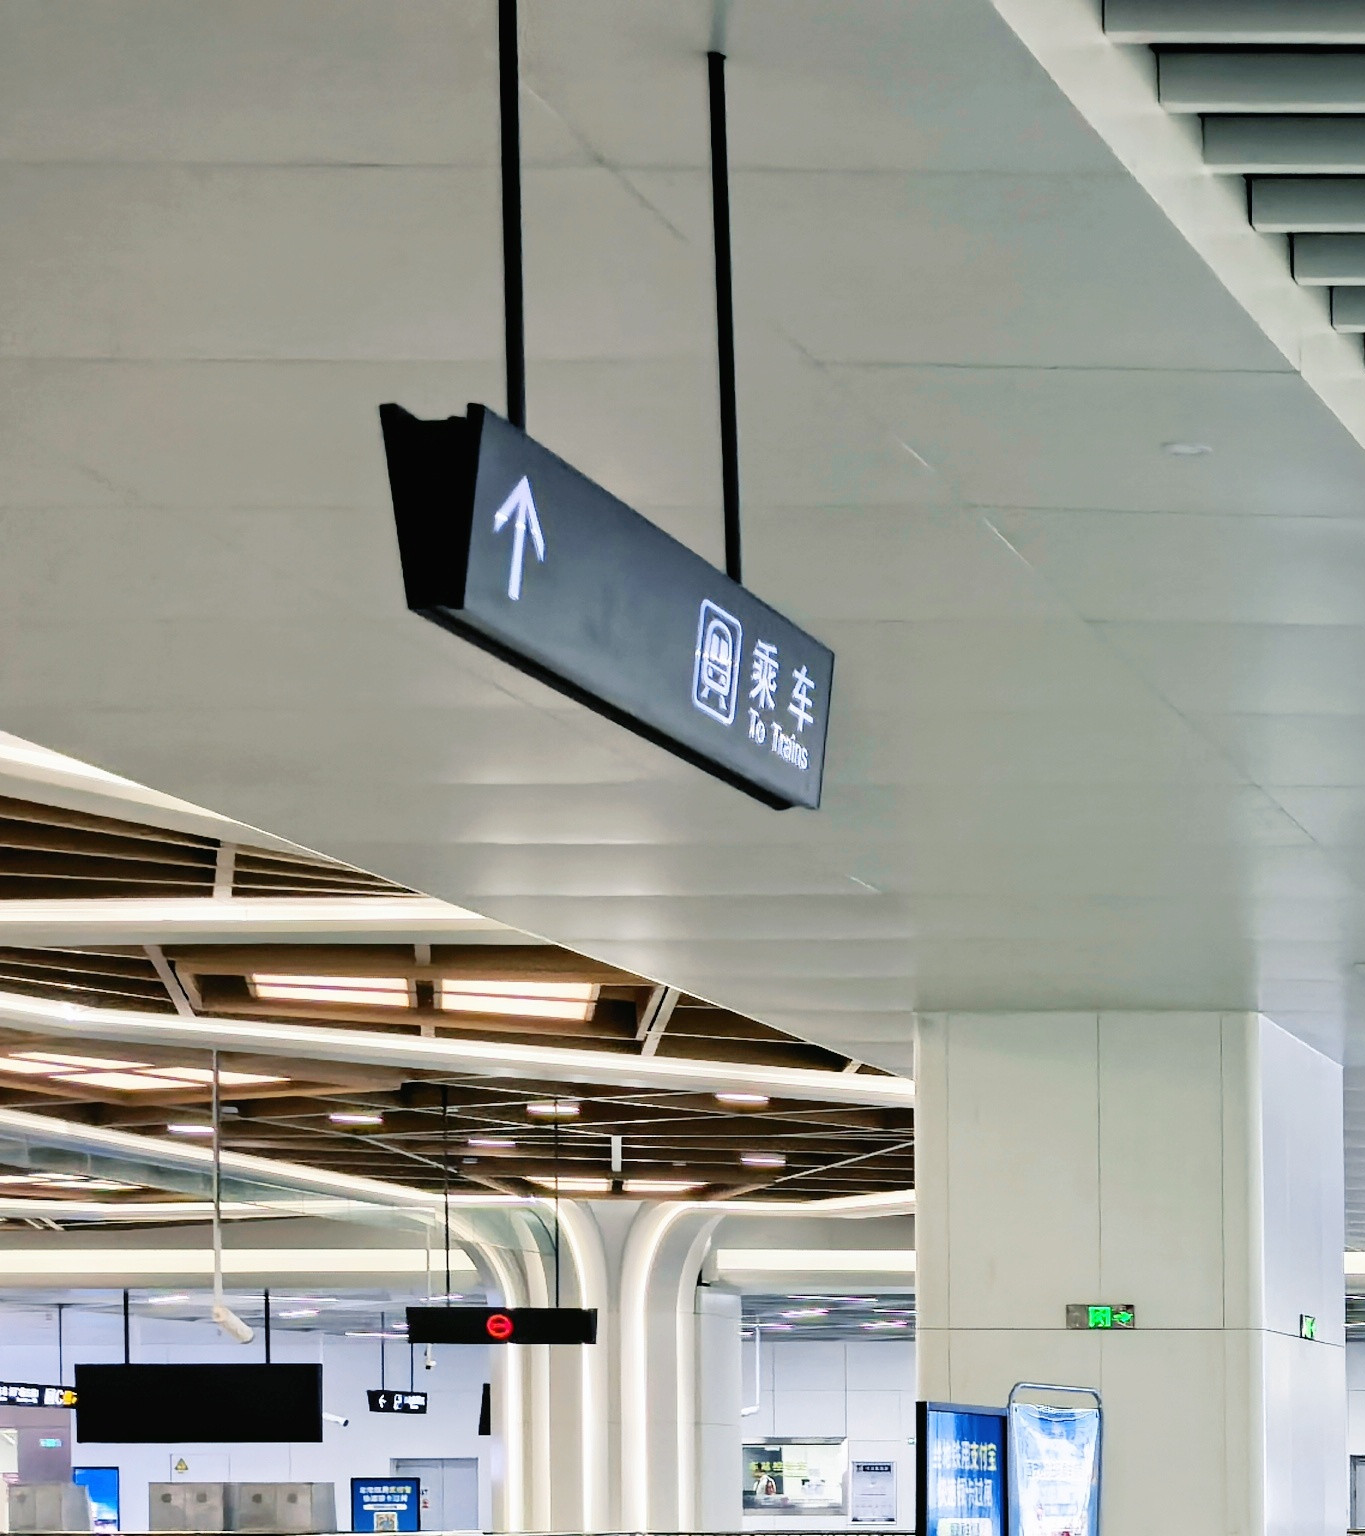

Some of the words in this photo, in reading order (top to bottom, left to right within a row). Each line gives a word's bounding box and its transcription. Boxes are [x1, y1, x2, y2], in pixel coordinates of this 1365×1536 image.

[747, 639, 816, 732] 乘车
[747, 707, 767, 744] To
[771, 719, 809, 771] Trains
